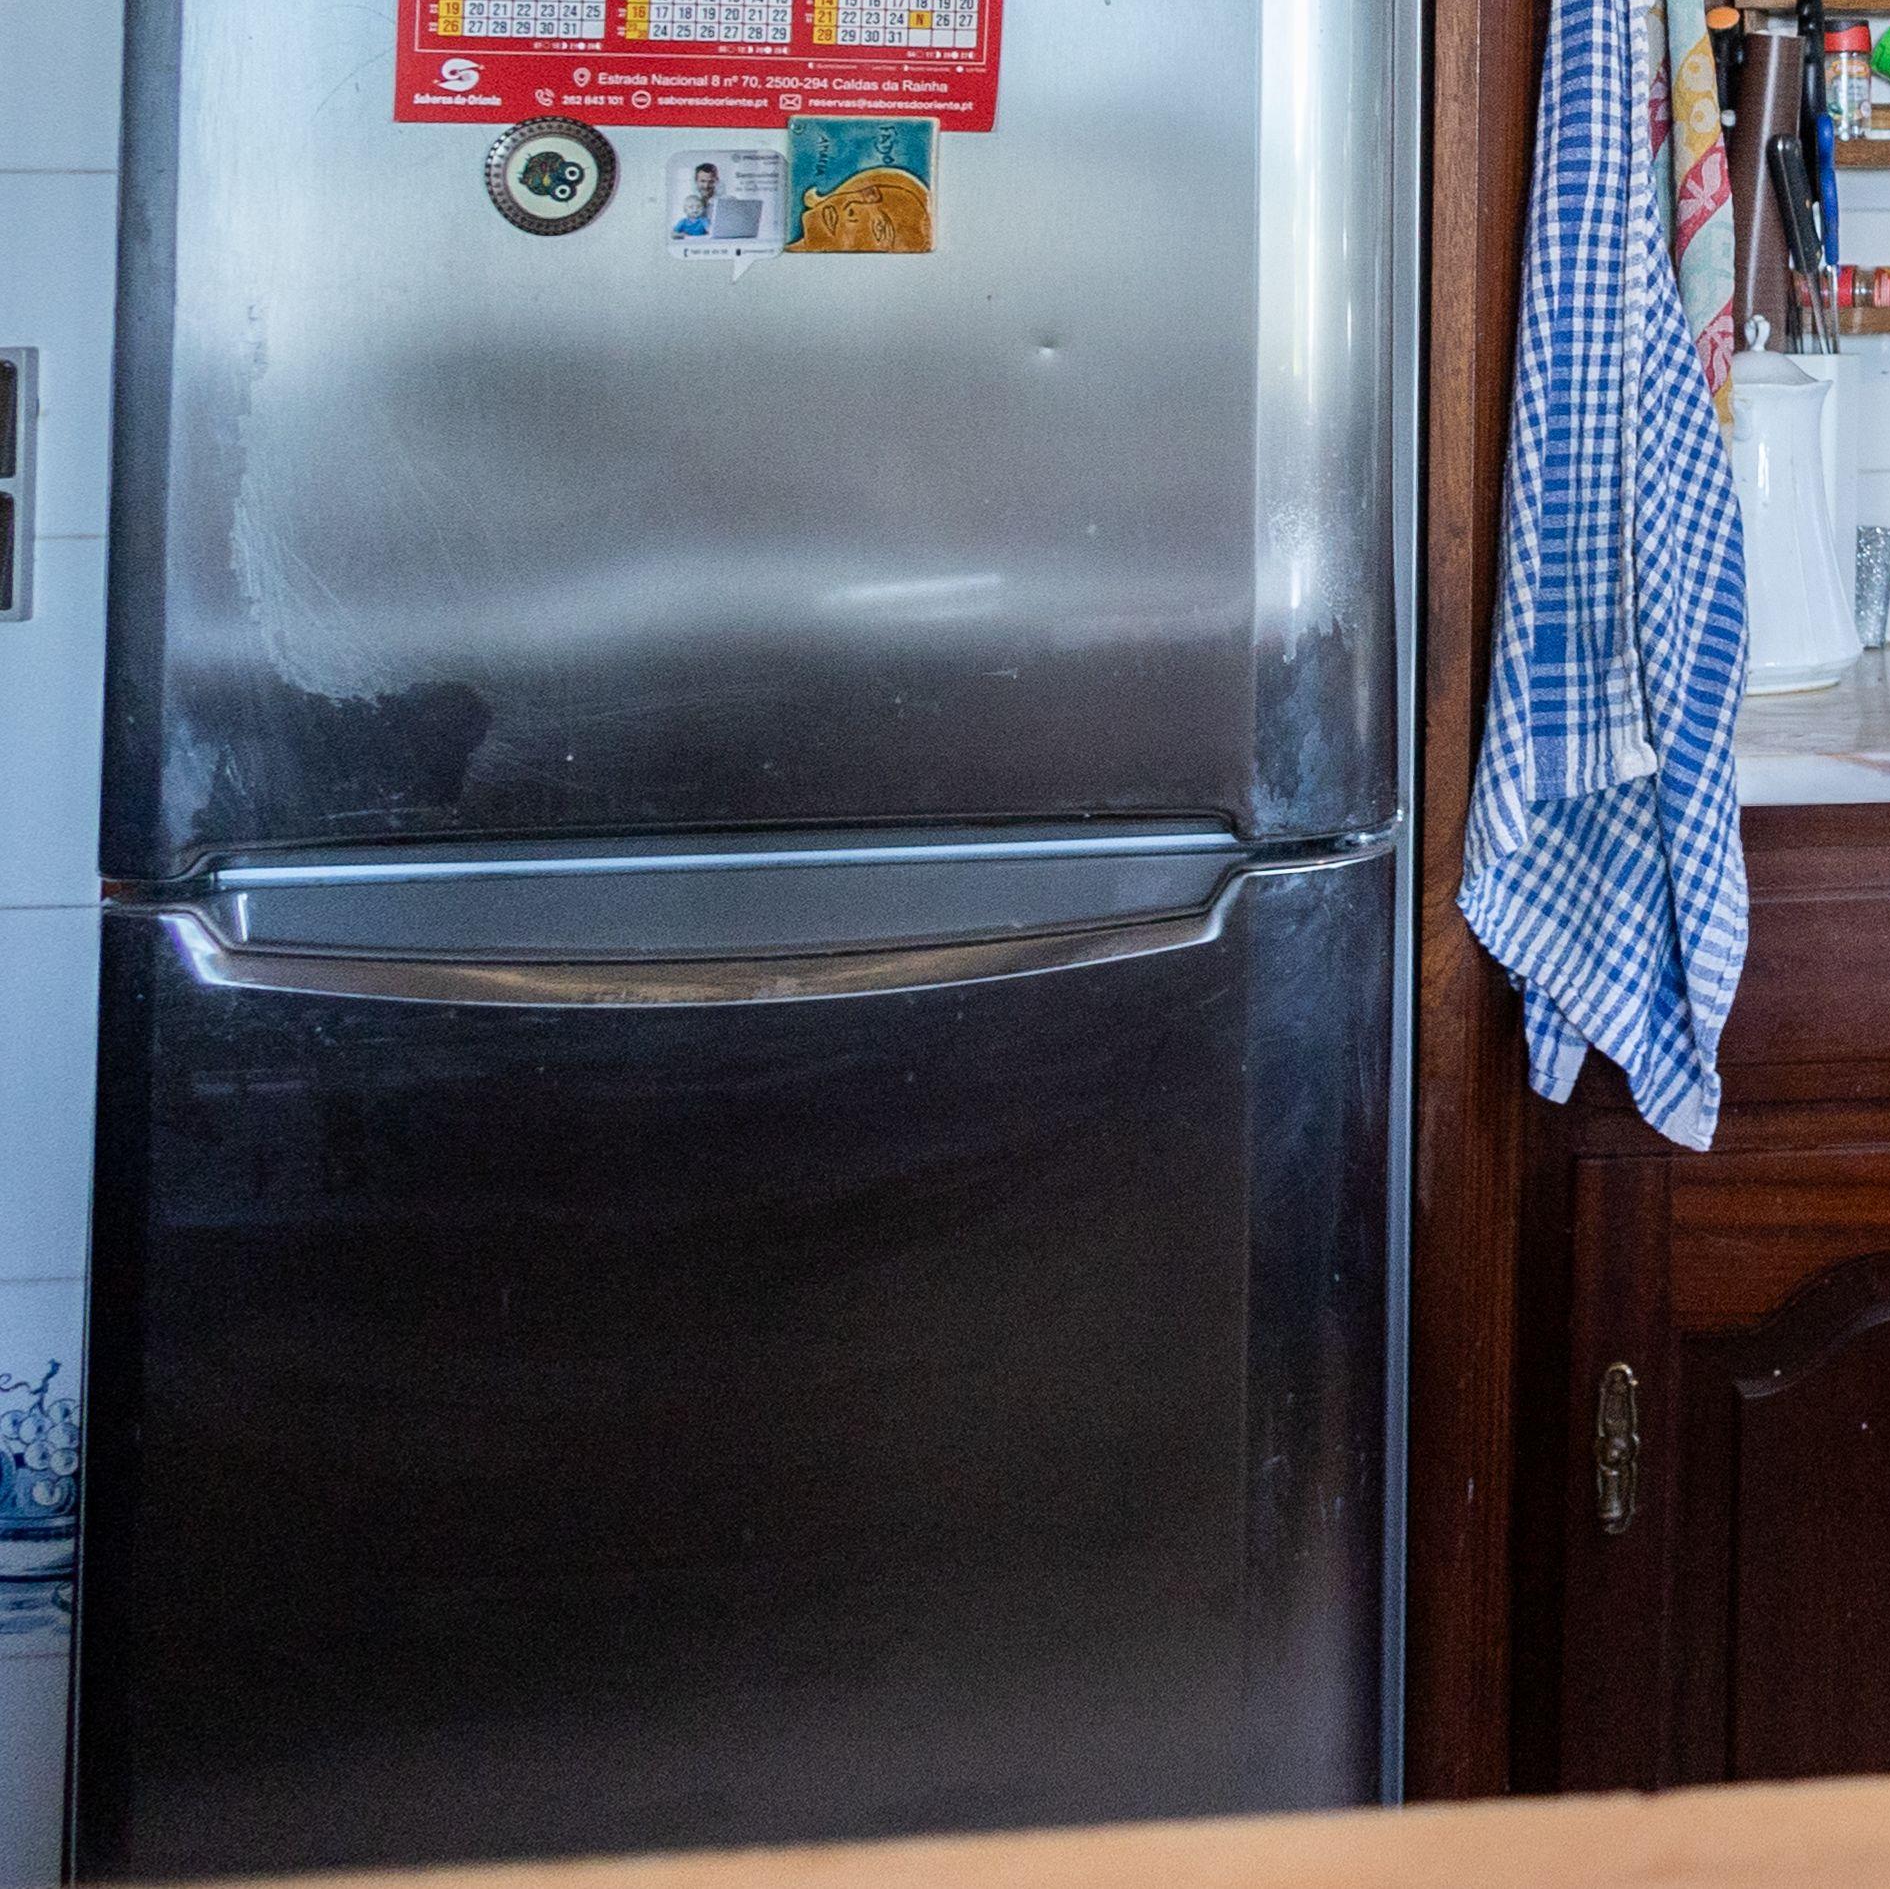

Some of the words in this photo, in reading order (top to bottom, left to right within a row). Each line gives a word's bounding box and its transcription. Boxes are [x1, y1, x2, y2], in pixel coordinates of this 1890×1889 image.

[842, 11, 857, 24] 22
[865, 12, 880, 25] 23
[889, 12, 904, 25] 24
[936, 13, 950, 27] 26
[959, 14, 973, 27] 27
[841, 29, 856, 42] 29
[865, 30, 880, 43] 30
[888, 30, 902, 43] 31
[598, 72, 648, 86] Estrada
[651, 73, 708, 87] Nacional
[711, 76, 720, 87] 8
[765, 77, 828, 90] 2500-294
[832, 78, 879, 91] Caldas
[882, 80, 899, 92] da
[902, 81, 948, 93] Rainha
